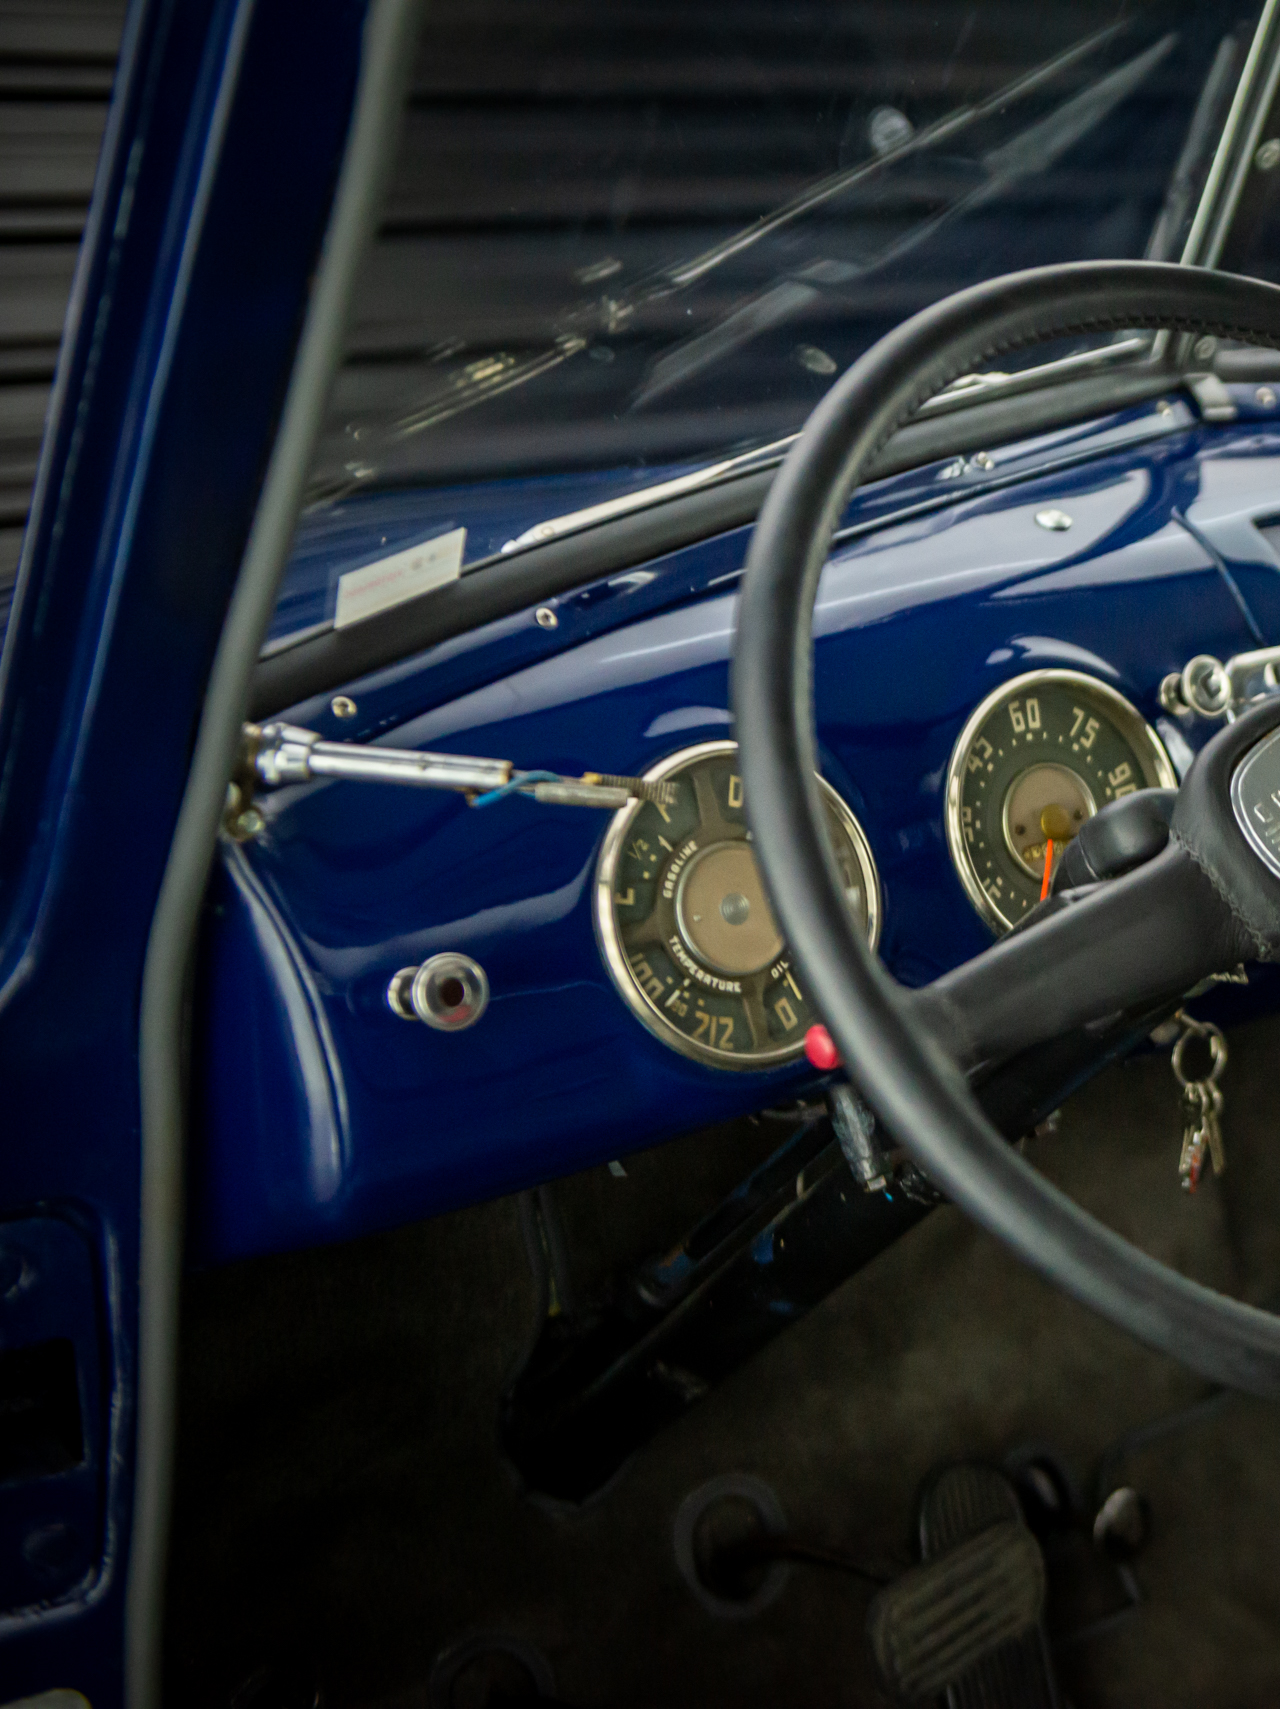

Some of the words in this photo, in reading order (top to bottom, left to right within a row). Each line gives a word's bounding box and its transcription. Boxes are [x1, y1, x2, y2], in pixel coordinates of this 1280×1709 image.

[1008, 698, 1041, 733] 60
[1070, 706, 1100, 748] 75
[966, 736, 993, 774] 45
[662, 840, 698, 899] GASOLINE
[669, 934, 742, 994] TEMPERATURE
[770, 960, 789, 980] OIL
[692, 1010, 734, 1050] 212
[774, 996, 798, 1031] 0
